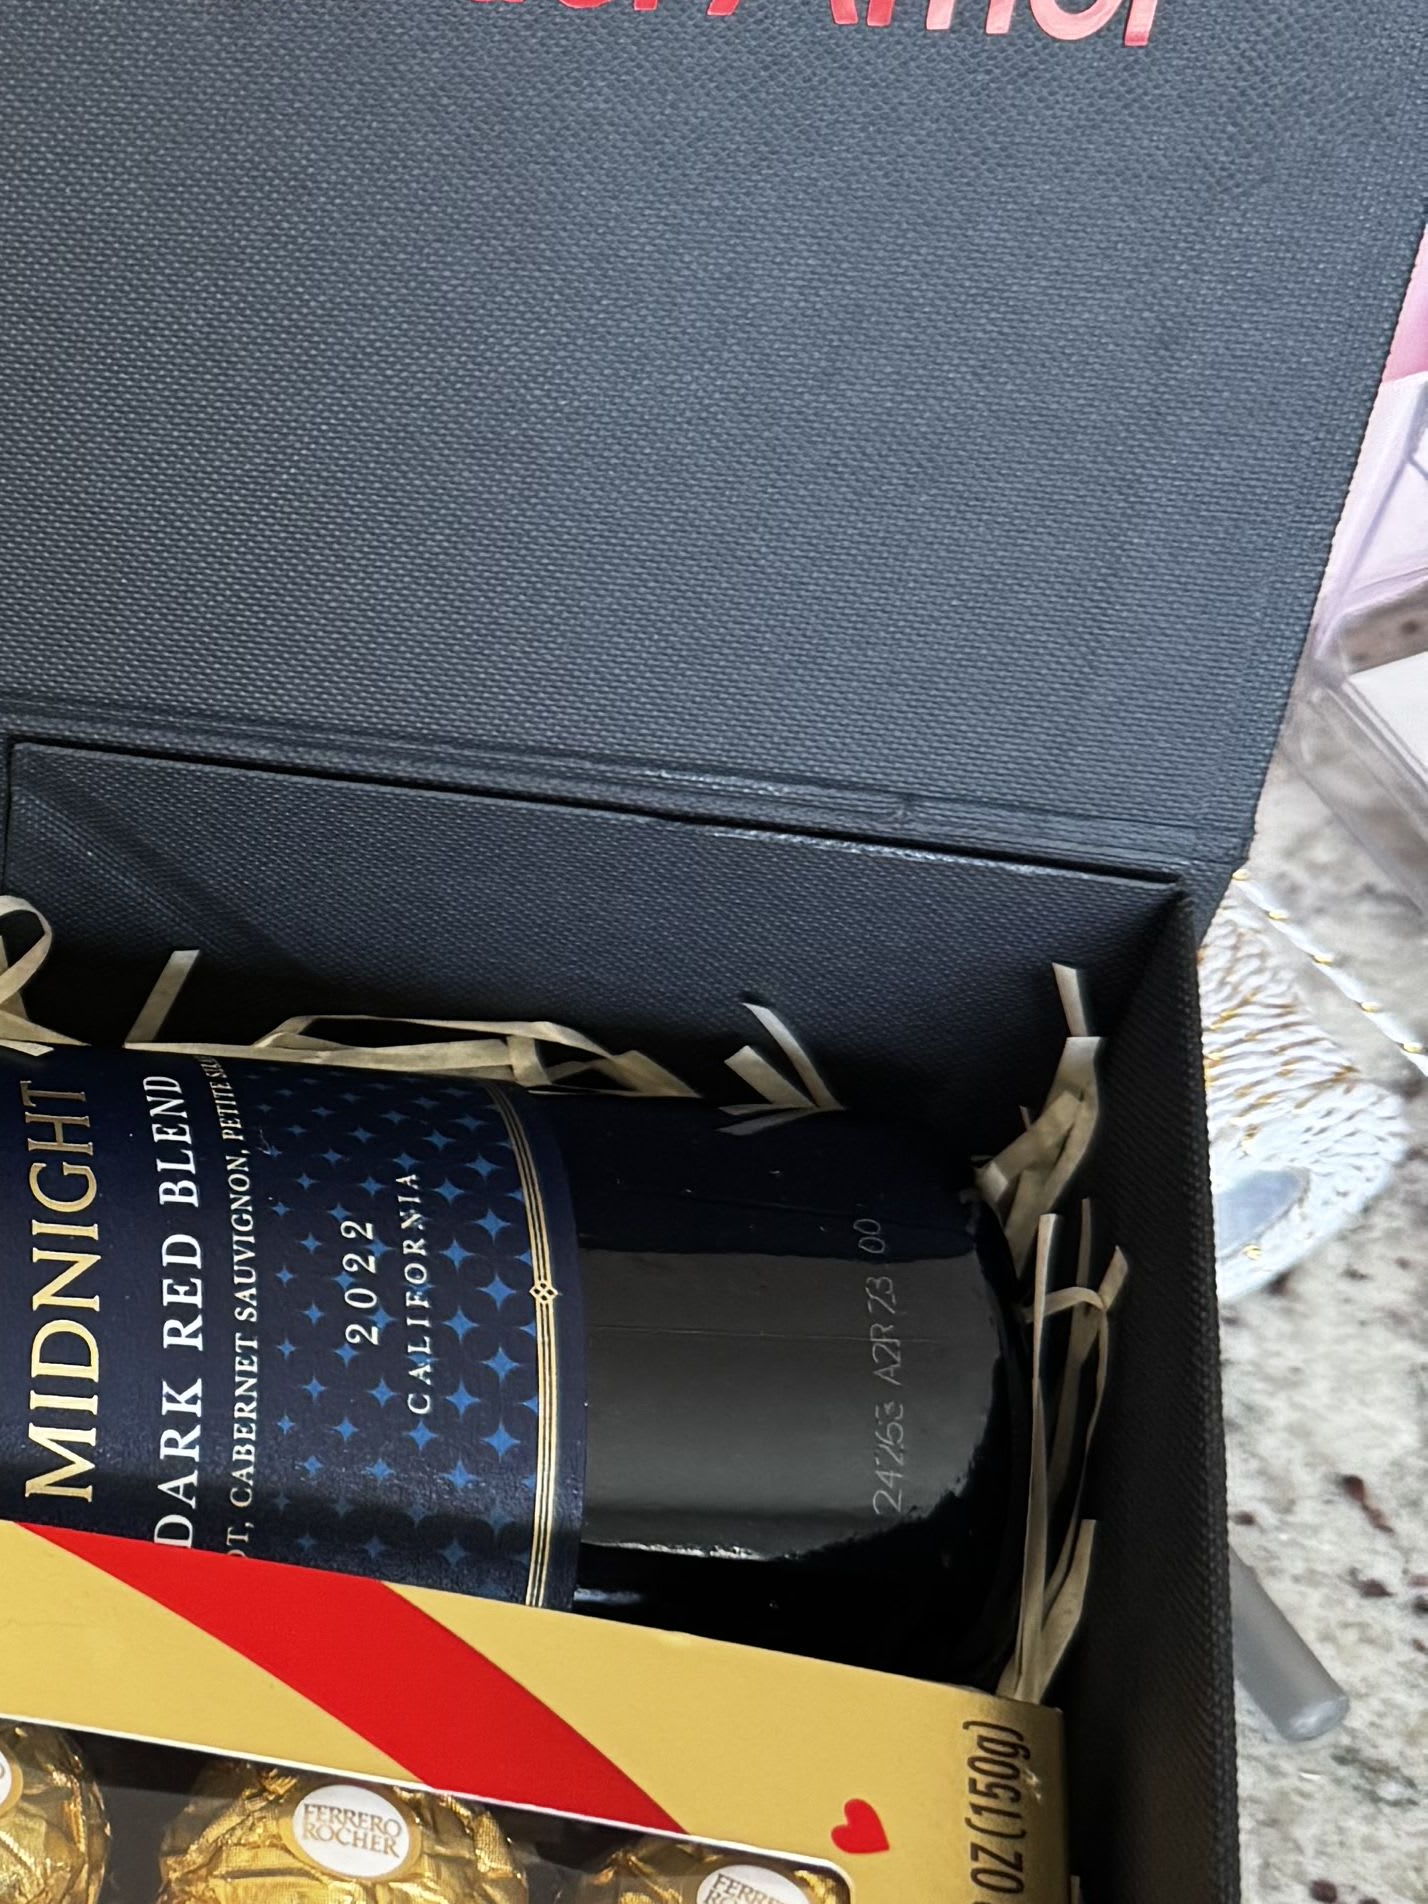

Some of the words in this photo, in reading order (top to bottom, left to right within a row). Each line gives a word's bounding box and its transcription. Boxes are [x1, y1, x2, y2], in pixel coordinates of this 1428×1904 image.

[144, 1074, 199, 1208] BLEND
[210, 1082, 244, 1141] PETITE
[20, 1080, 101, 1503] MIDNIGHT
[161, 1233, 203, 1351] RED
[226, 1149, 257, 1321] SAUVIGNON,
[341, 1220, 379, 1348] 2022
[397, 1173, 432, 1415] CALIFORNIA
[154, 1378, 203, 1549] DARK
[229, 1337, 258, 1507] CABERNET
[301, 1822, 400, 1858] ROCHER
[303, 1803, 402, 1838] FERRERO
[962, 1720, 1032, 1840] (150g)
[969, 1845, 1024, 1894] OZ
